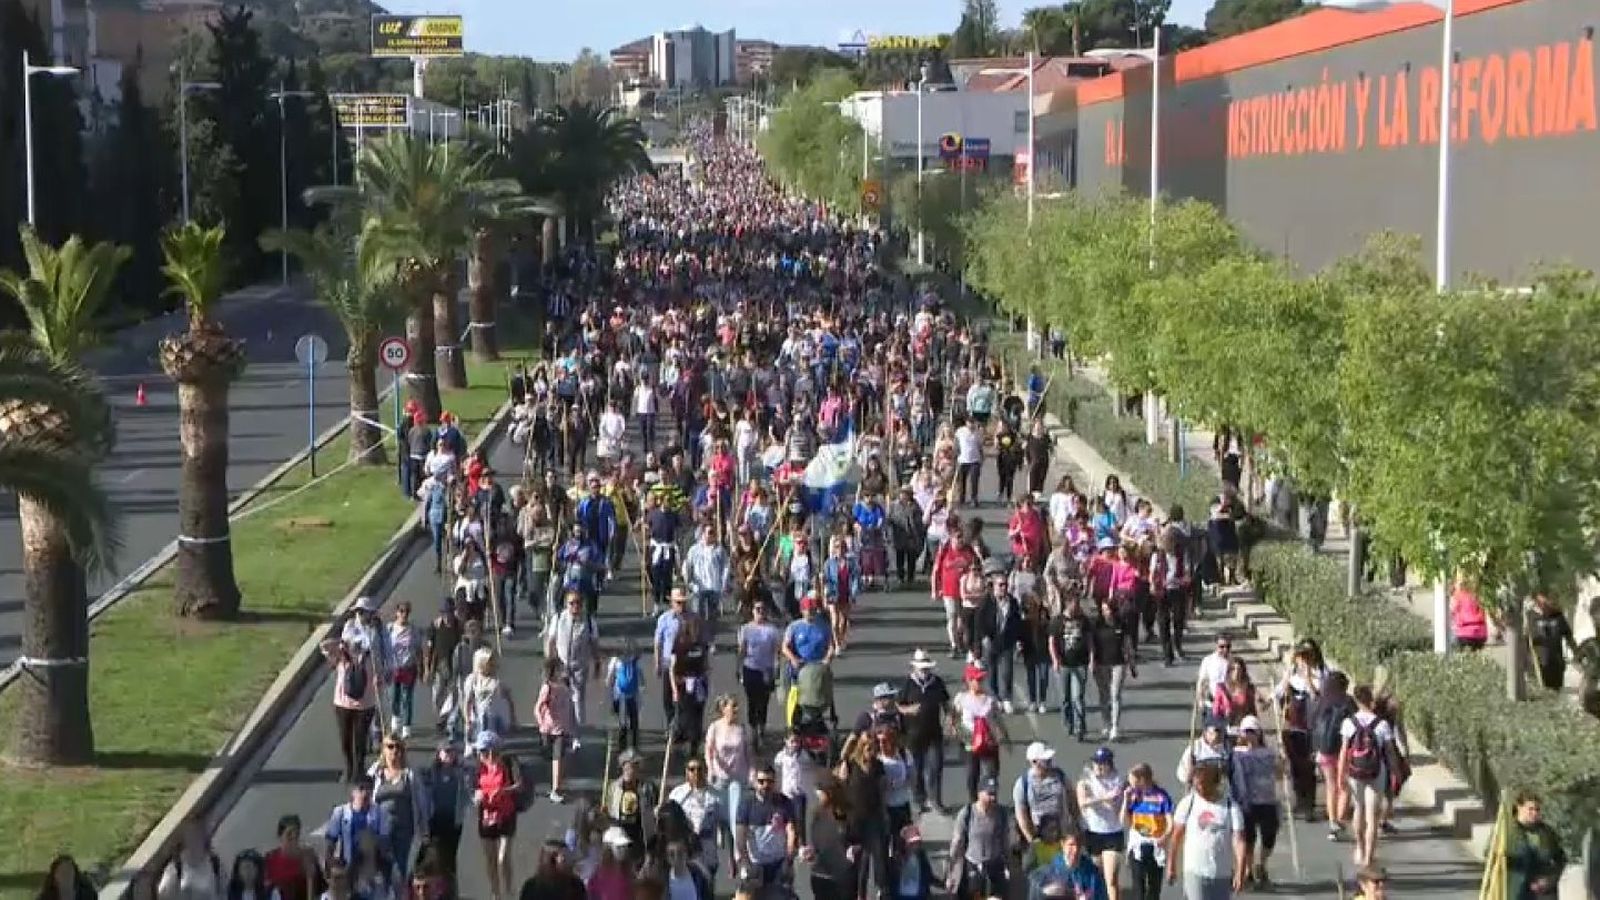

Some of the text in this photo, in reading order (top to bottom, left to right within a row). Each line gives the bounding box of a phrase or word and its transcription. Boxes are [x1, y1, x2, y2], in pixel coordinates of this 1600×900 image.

[1355, 77, 1372, 149] Y
[1378, 70, 1409, 146] LA
[387, 347, 404, 358] 50
